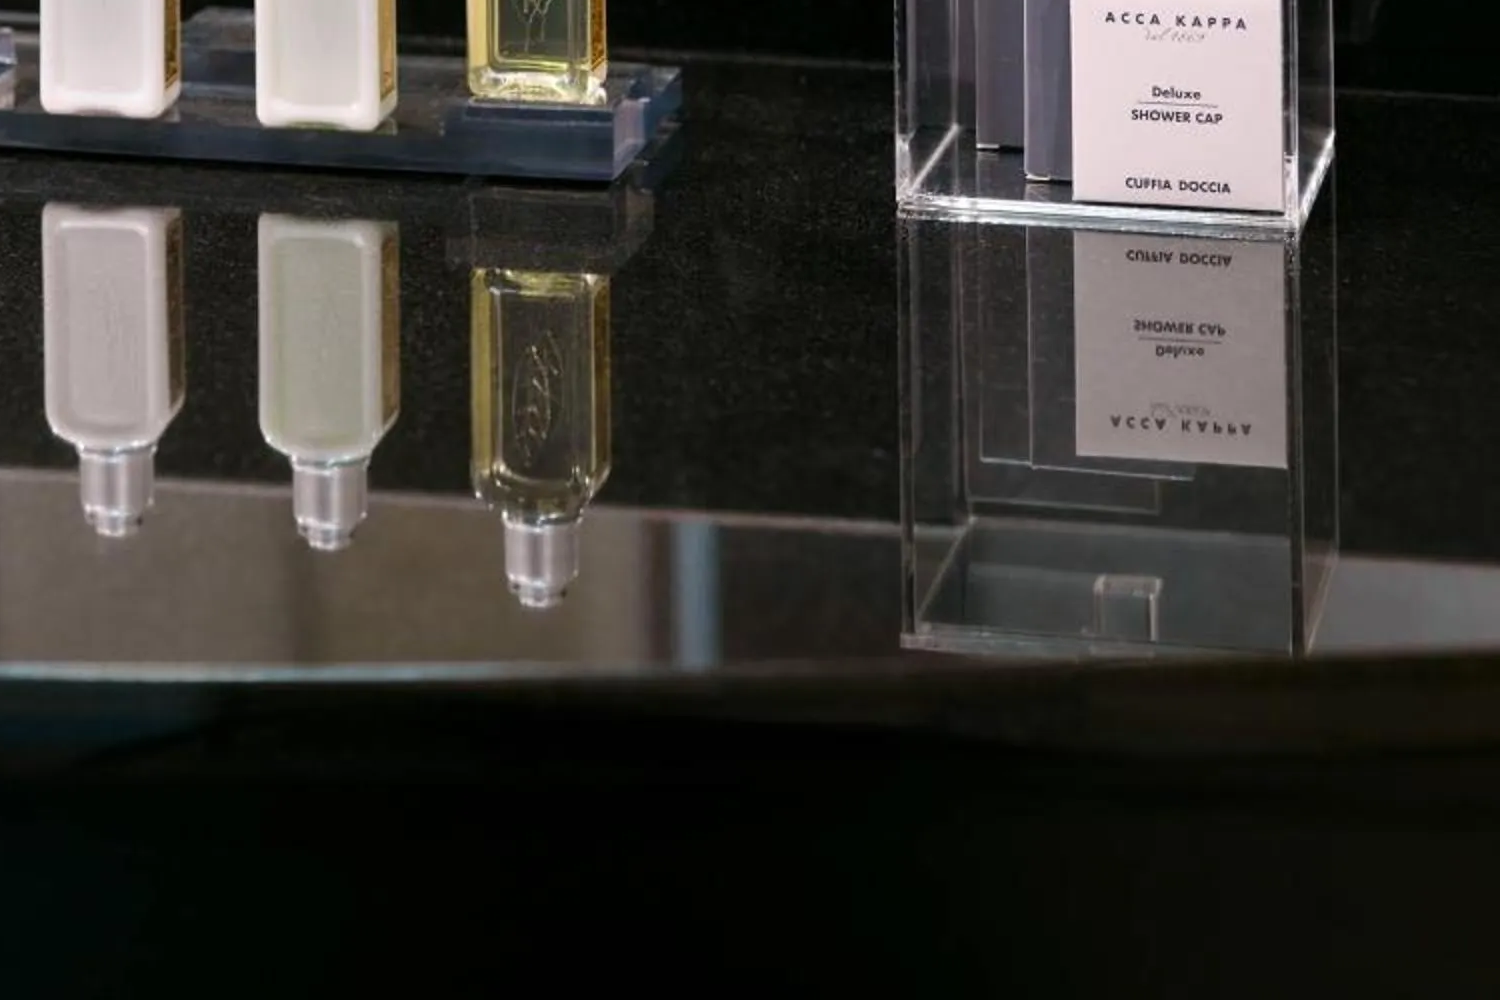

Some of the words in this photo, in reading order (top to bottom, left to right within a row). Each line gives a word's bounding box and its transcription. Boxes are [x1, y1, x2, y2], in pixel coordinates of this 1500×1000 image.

[1104, 11, 1161, 26] ACCA
[1175, 15, 1247, 31] KAPPA
[1151, 85, 1202, 101] Deluxe
[1131, 108, 1191, 124] SHOWER
[1195, 112, 1224, 125] CAP
[1125, 176, 1173, 191] CUFFIA
[1178, 179, 1232, 194] DOCCIA
